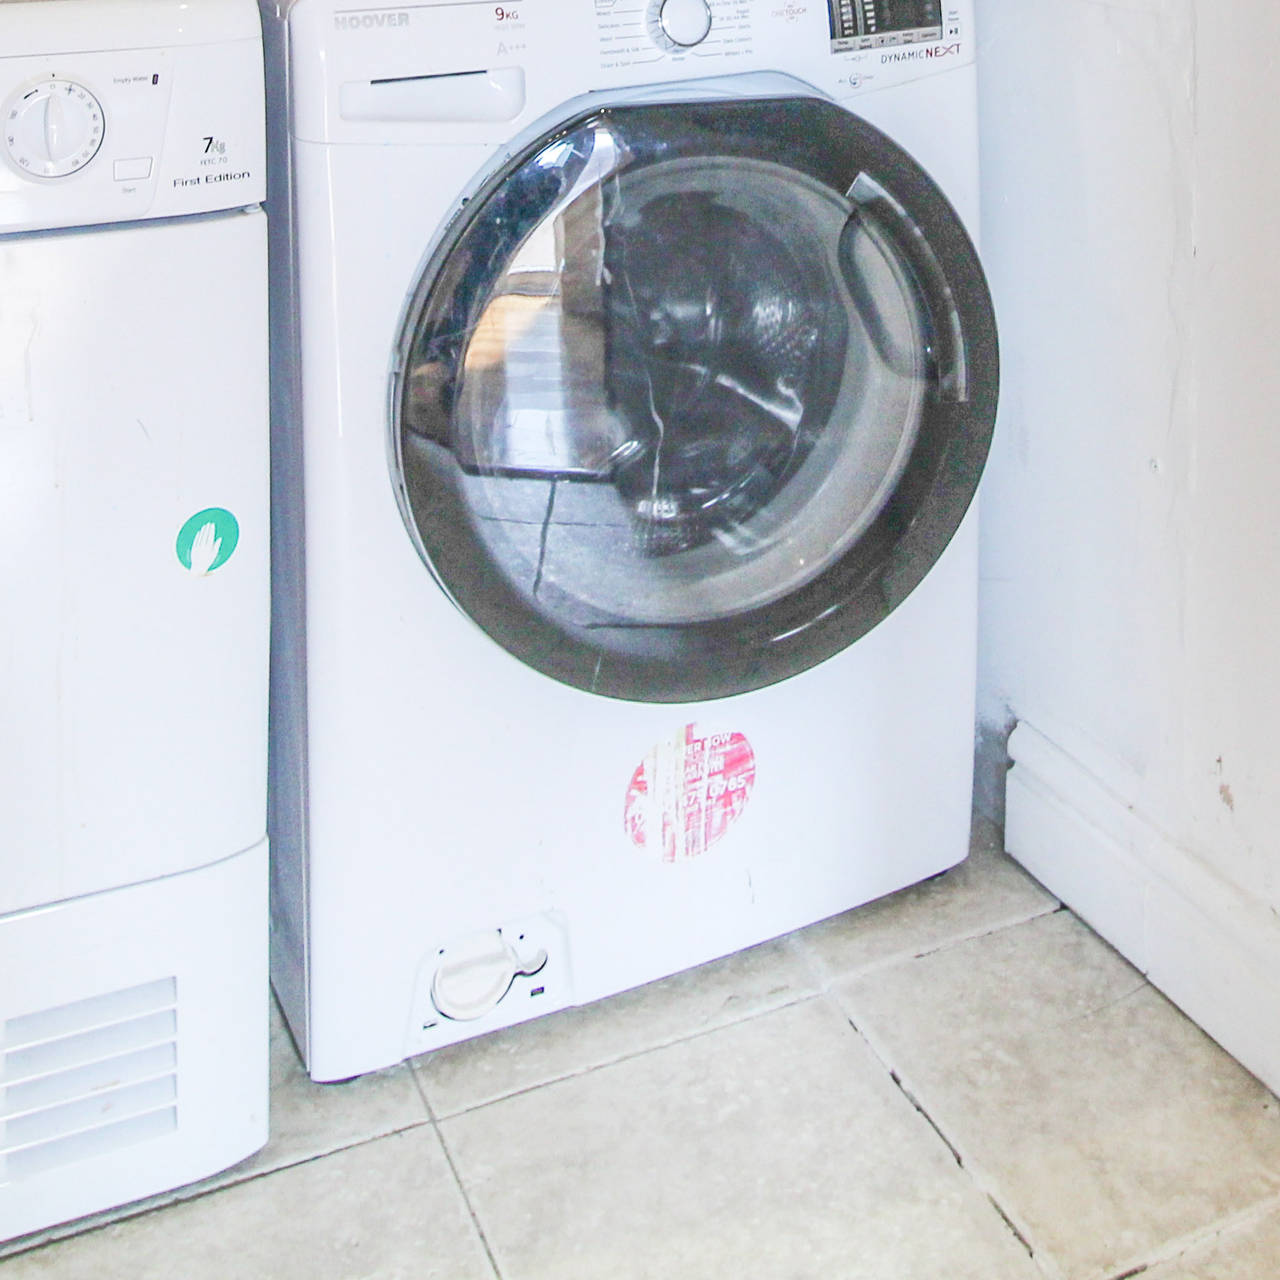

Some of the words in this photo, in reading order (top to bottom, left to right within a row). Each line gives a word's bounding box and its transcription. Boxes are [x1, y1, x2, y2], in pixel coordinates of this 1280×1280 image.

[334, 12, 410, 30] HOOVER
[173, 176, 201, 188] First
[205, 170, 251, 184] Edition
